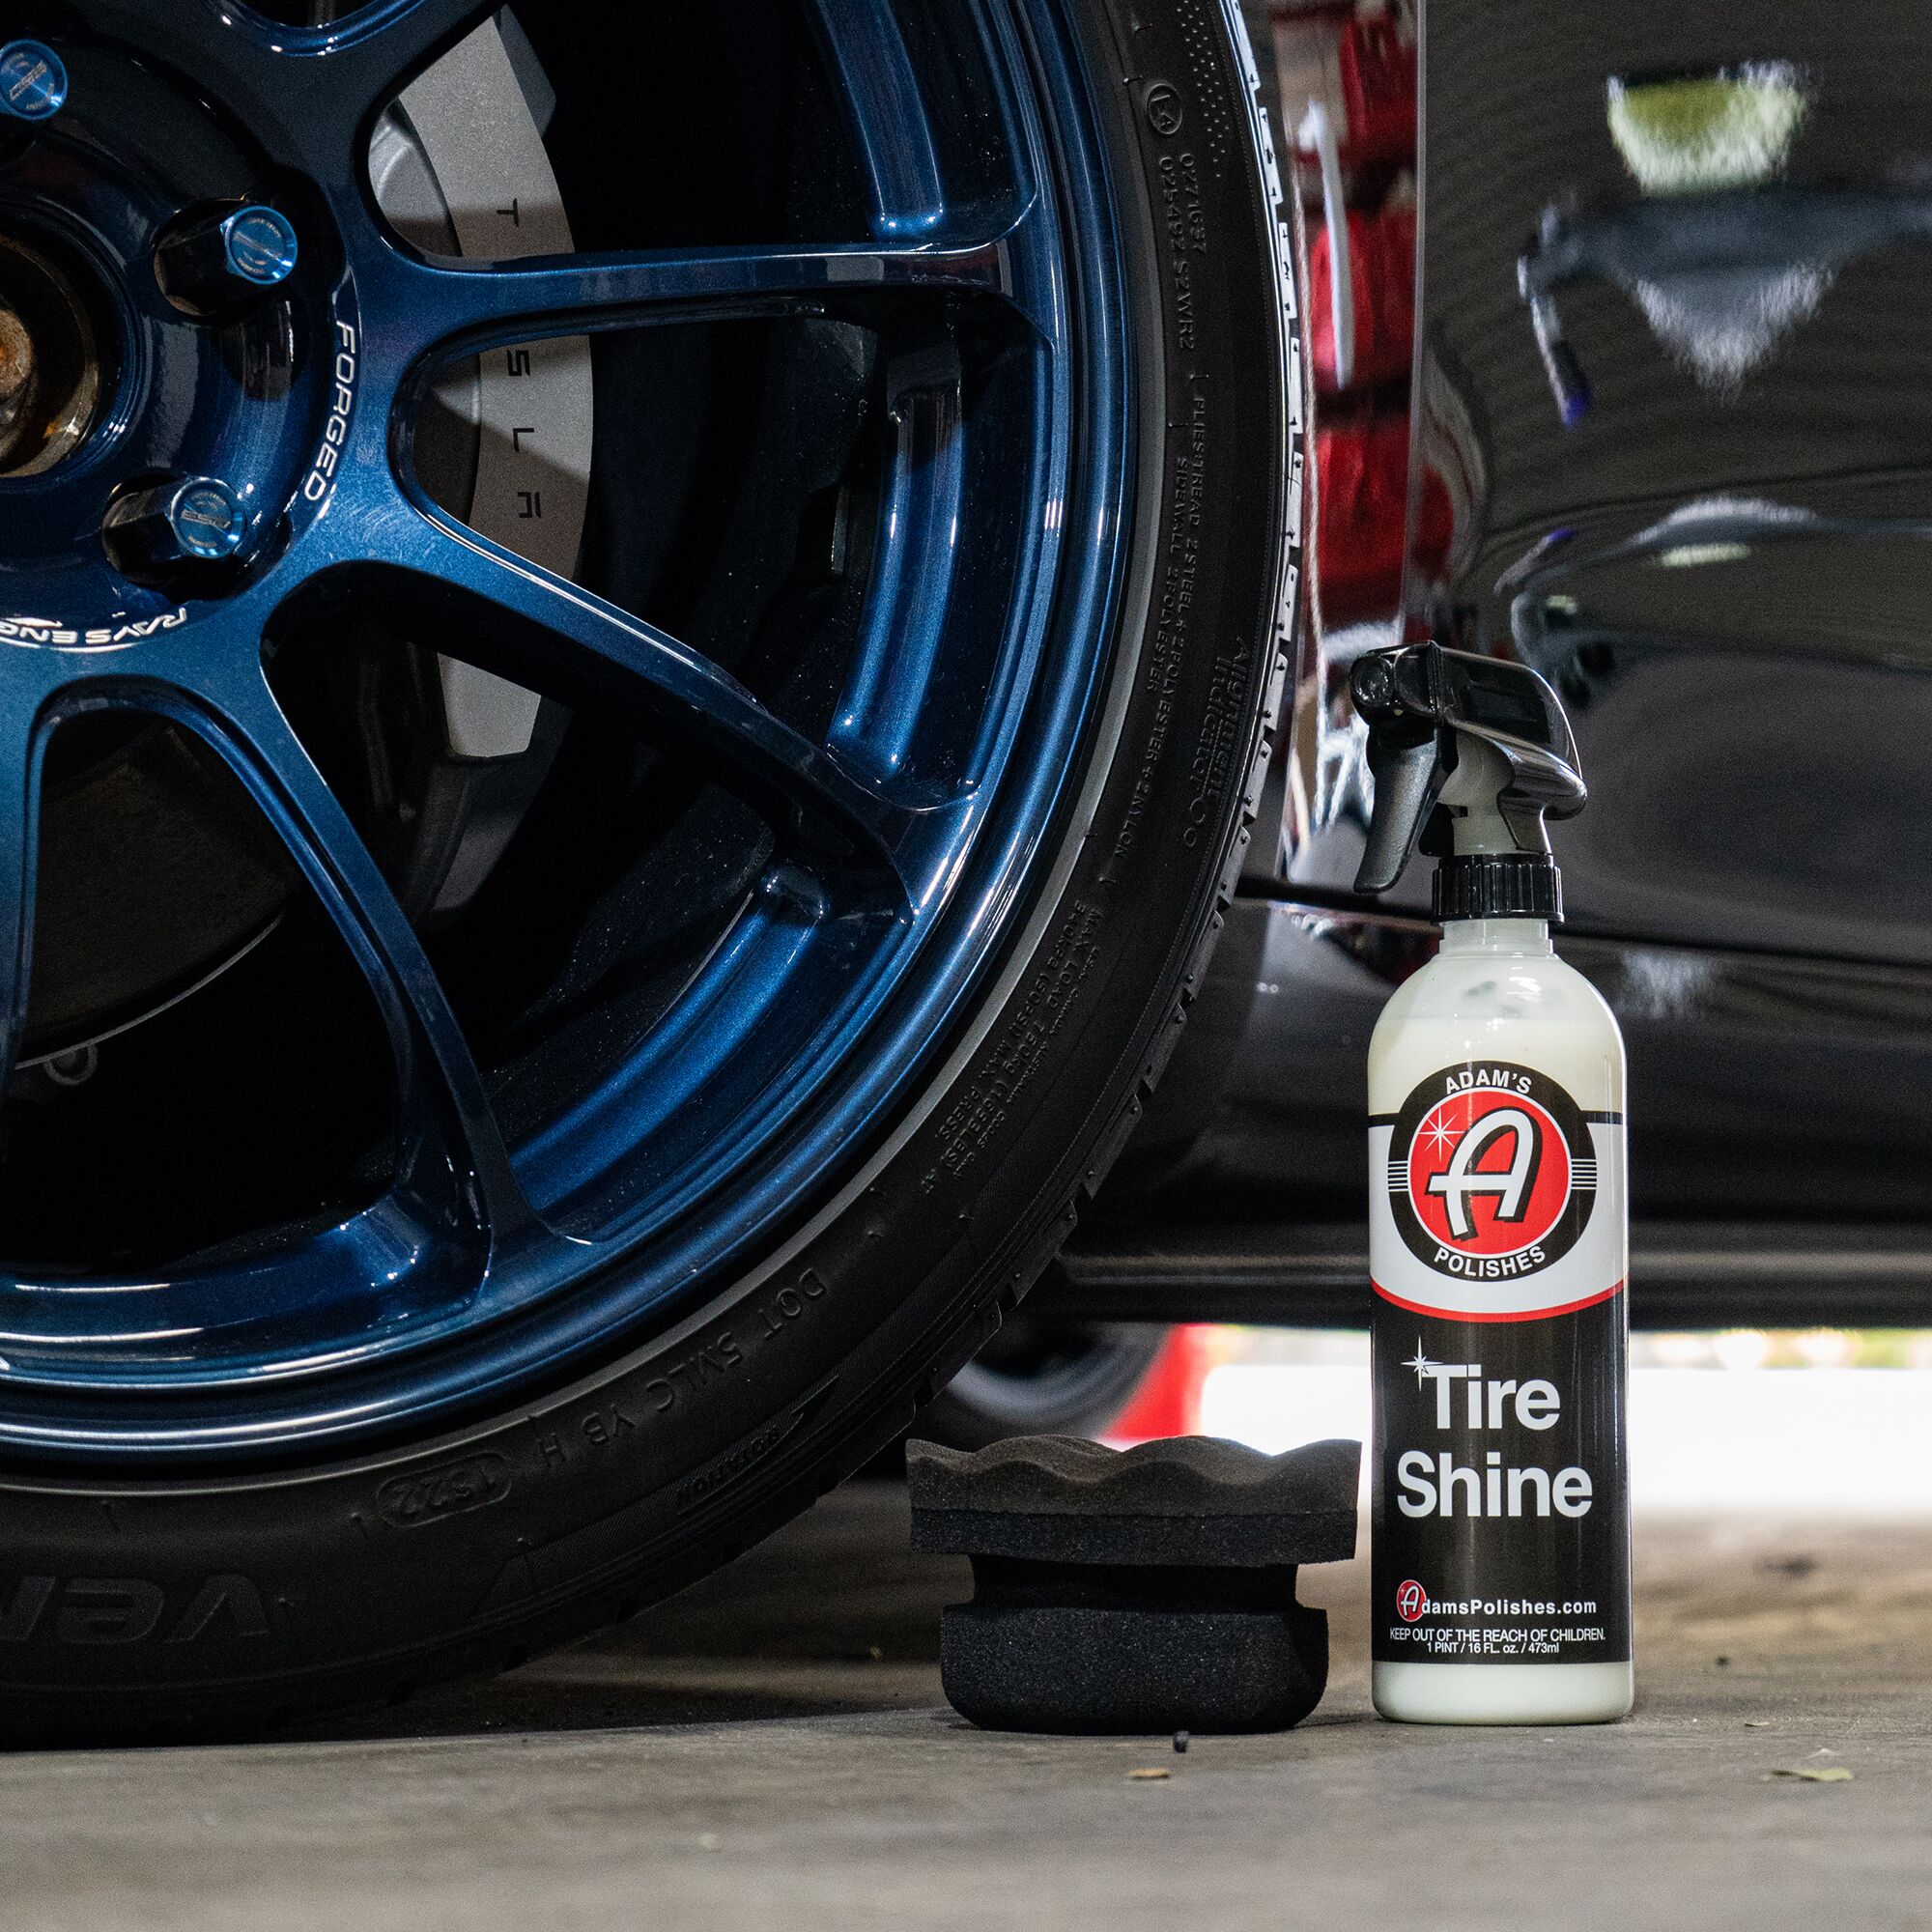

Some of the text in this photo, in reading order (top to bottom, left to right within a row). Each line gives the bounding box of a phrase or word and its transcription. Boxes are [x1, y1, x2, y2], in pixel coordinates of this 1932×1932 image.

[304, 320, 355, 500] FORGED
[1044, 958, 1079, 1009] LOAD
[1445, 1068, 1532, 1094] ADAM'S
[1434, 1245, 1546, 1277] POLISHES
[759, 1266, 827, 1342] DOT
[1422, 1362, 1561, 1431] Tire
[1397, 1450, 1593, 1518] Shine
[1389, 1628, 1606, 1642] KEEP OUT OF THE REACH OF CHILDREN.
[1427, 1641, 1432, 1653] 1
[1435, 1642, 1459, 1653] PINT
[1468, 1642, 1482, 1654] 16
[1483, 1642, 1500, 1654] FL.
[1502, 1644, 1520, 1654] oz.
[1528, 1642, 1560, 1654] 473ml
